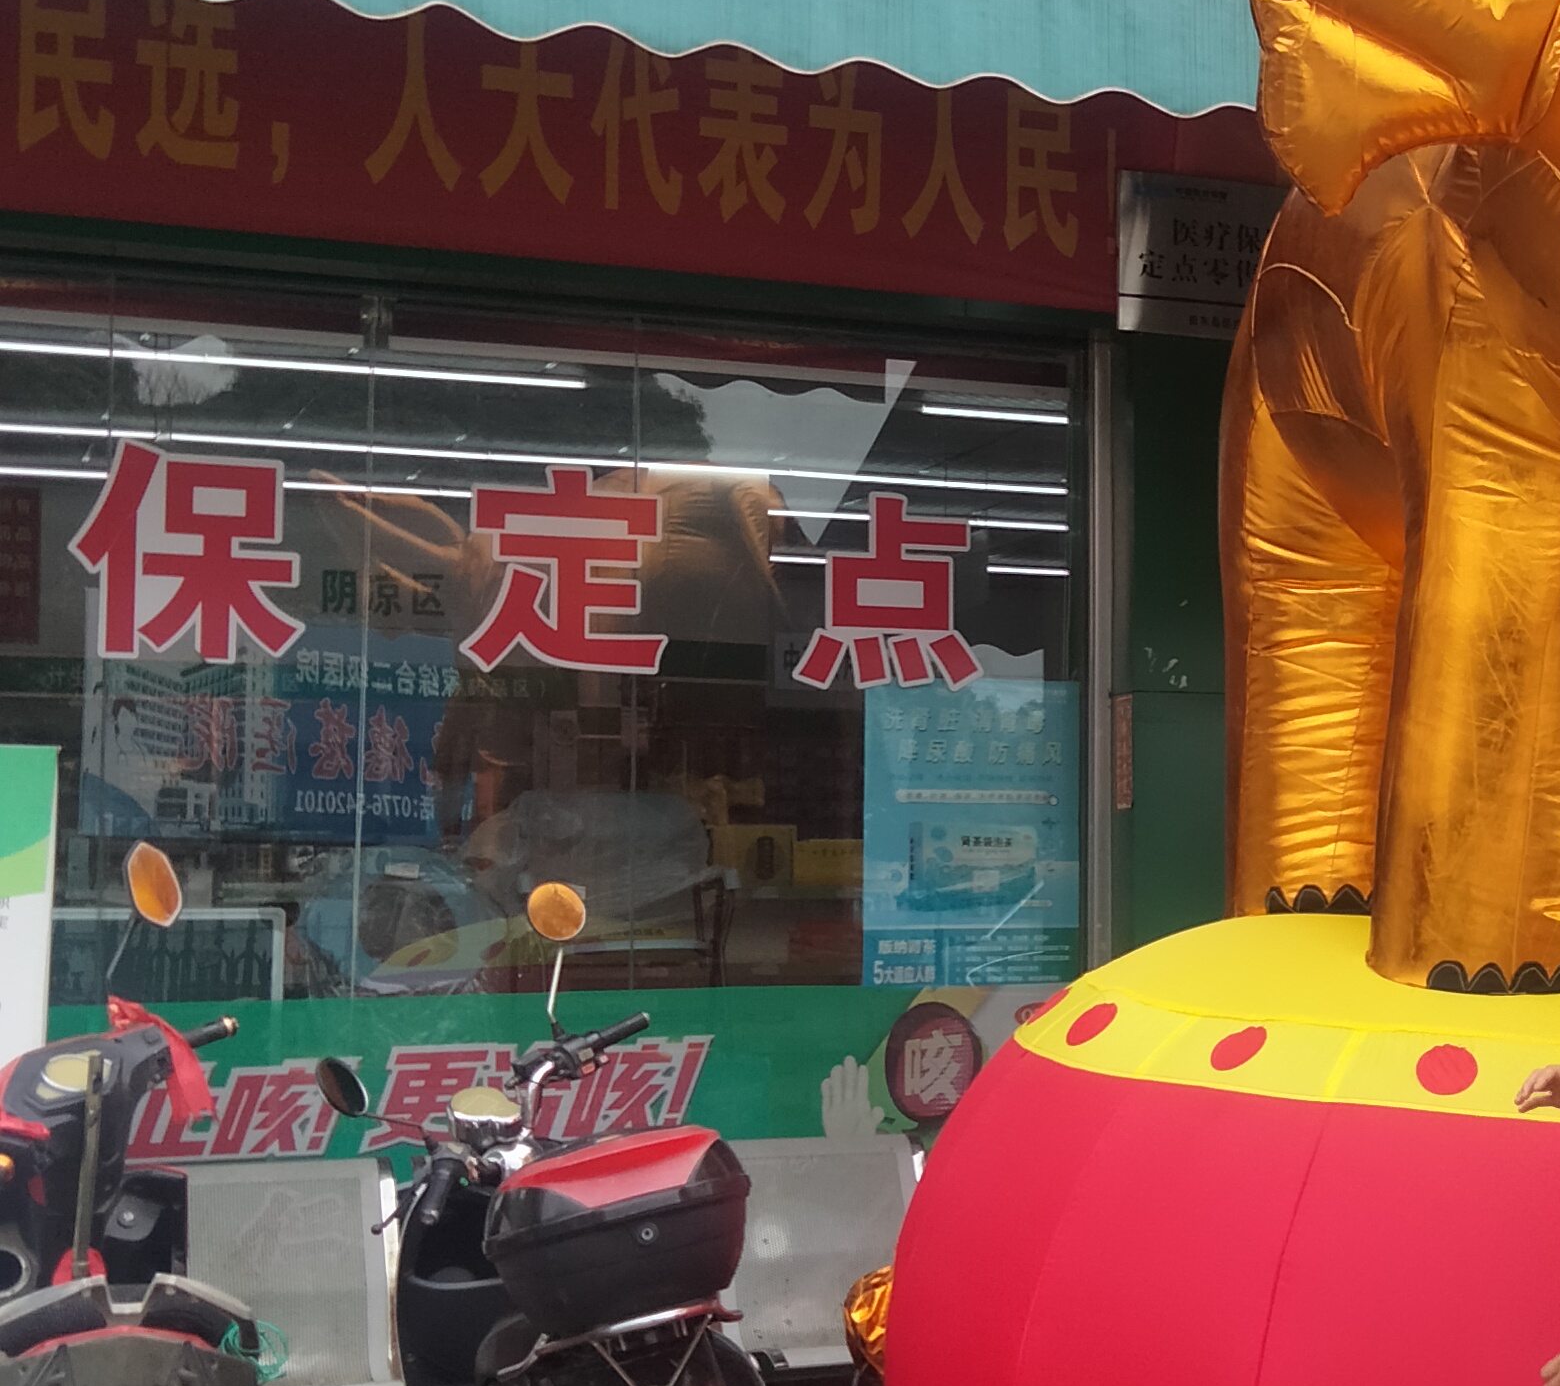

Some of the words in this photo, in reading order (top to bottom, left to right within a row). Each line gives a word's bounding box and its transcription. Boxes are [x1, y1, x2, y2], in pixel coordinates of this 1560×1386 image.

[1173, 217, 1264, 255] 医疗保
[69, 438, 983, 691] 保定点
[322, 569, 445, 616] 阴凉区
[905, 1029, 962, 1105] 咳
